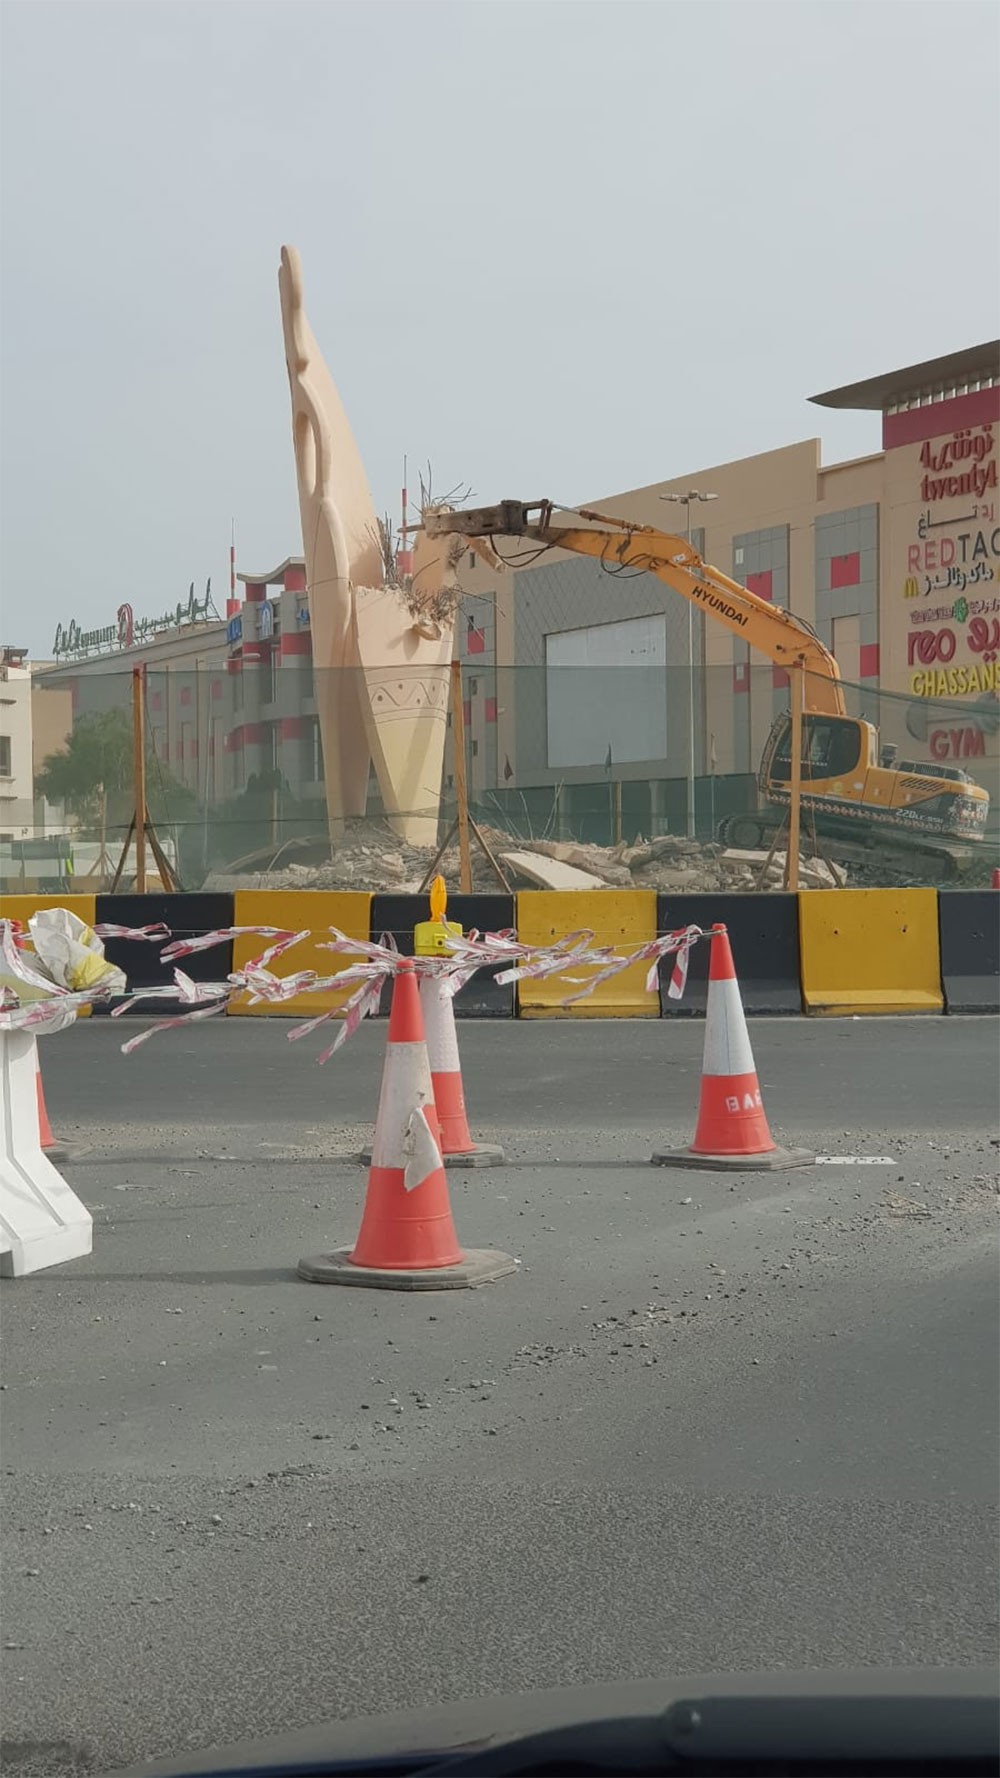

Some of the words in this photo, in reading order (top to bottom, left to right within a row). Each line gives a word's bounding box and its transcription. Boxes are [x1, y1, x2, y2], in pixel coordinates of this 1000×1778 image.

[920, 459, 998, 502] twenty4
[981, 502, 994, 522] رد
[692, 585, 749, 627] HYUNDAI
[907, 627, 956, 667] reo
[967, 616, 1000, 663] يو
[929, 727, 986, 761] GYM
